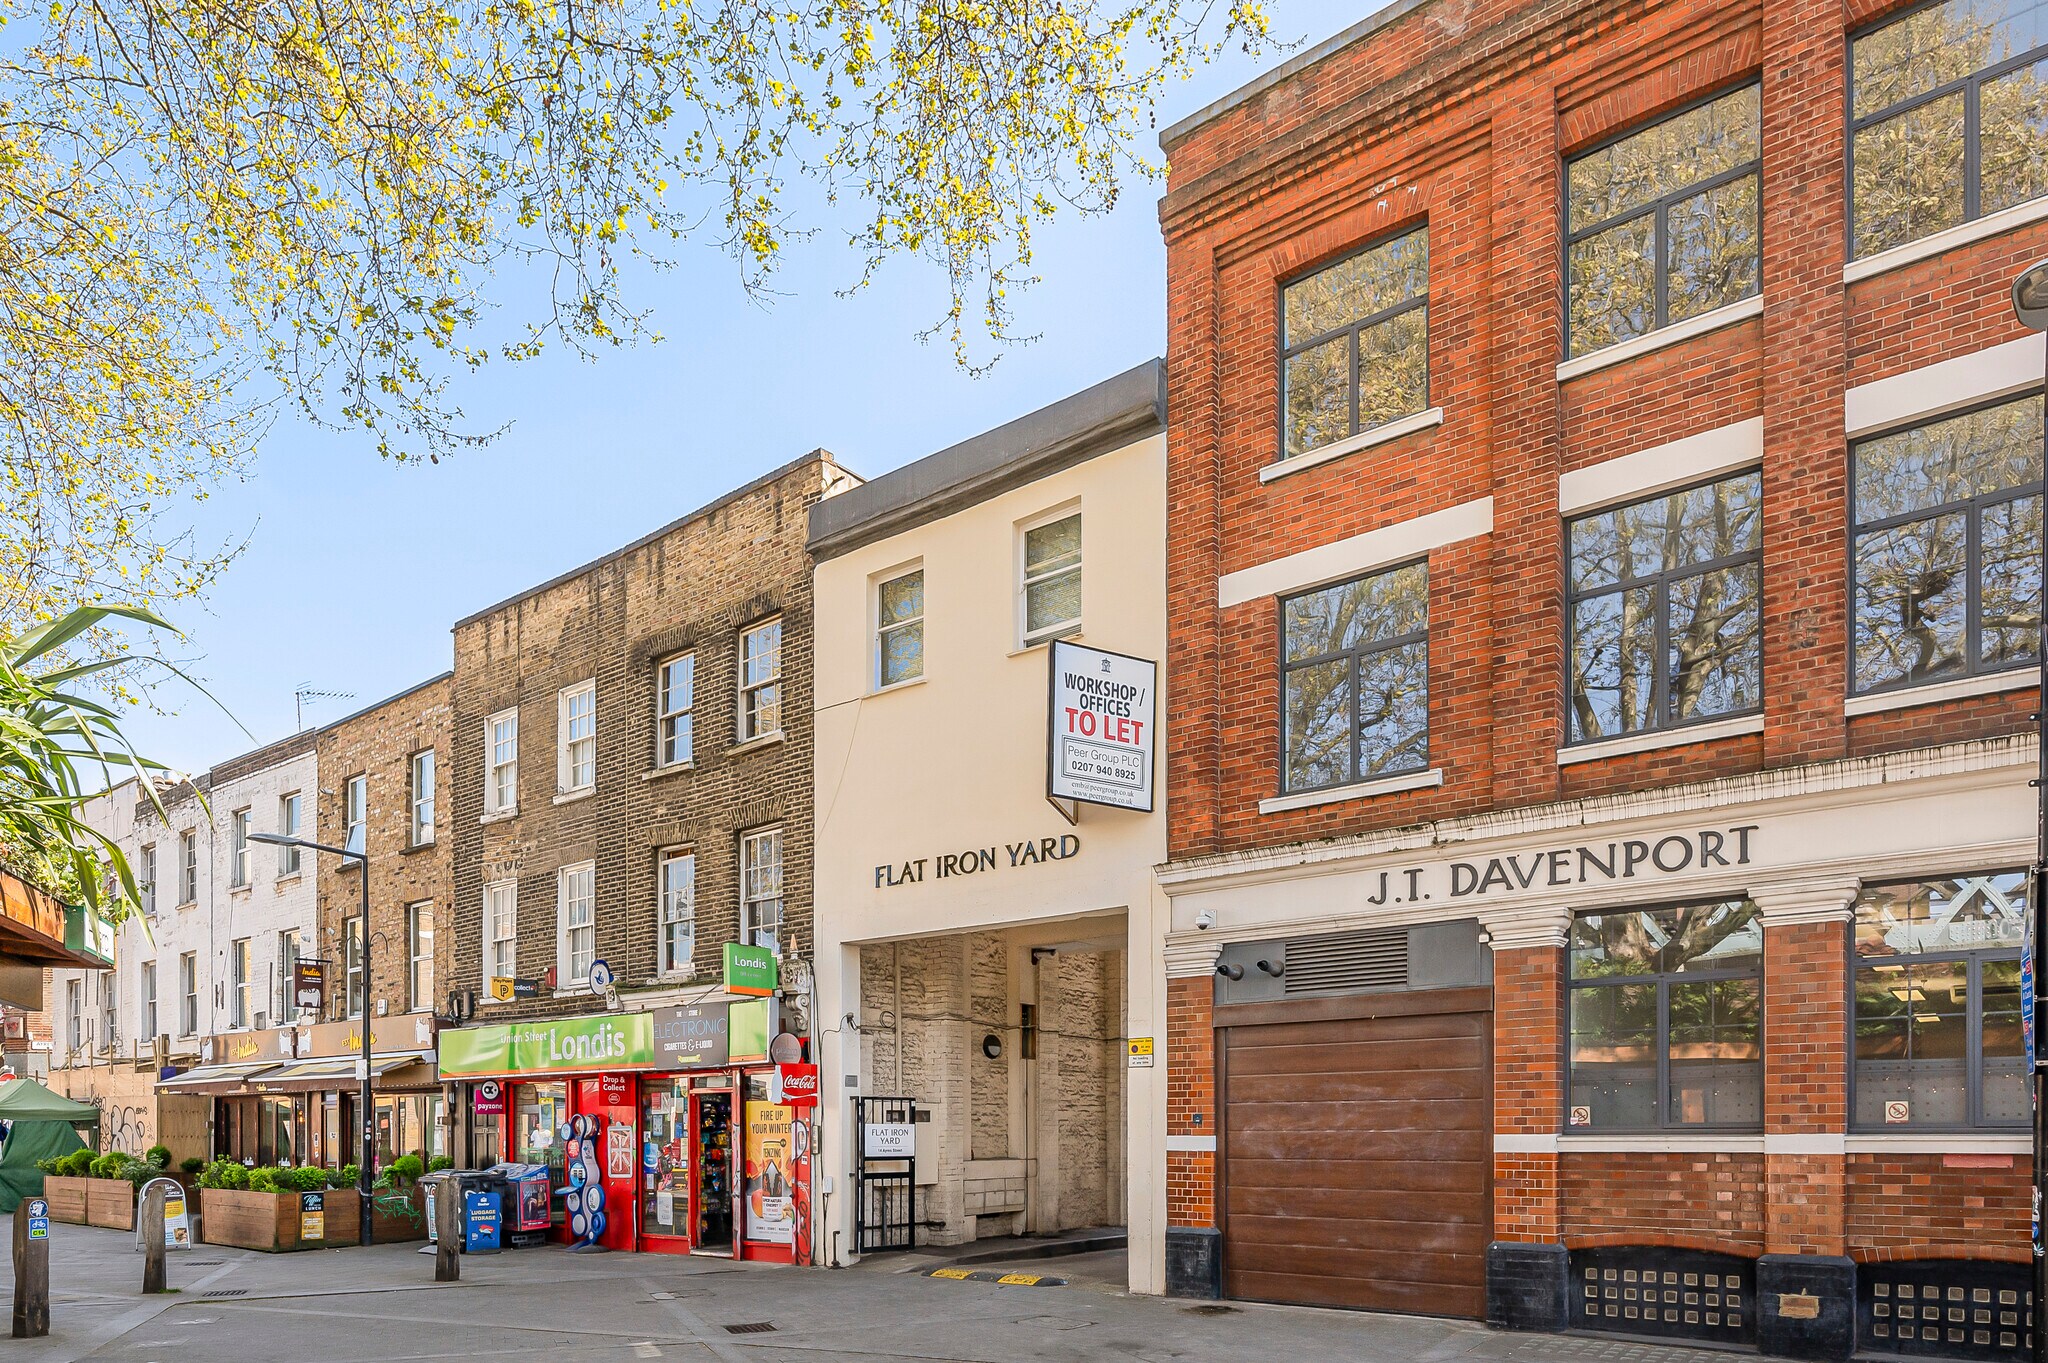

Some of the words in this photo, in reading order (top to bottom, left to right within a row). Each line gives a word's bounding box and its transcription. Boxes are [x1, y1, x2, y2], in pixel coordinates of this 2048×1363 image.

[1064, 672, 1136, 702] WORKSHOP
[1080, 694, 1130, 718] OFFICES
[1065, 707, 1096, 736] TO
[1104, 716, 1144, 745] LET
[1068, 745, 1088, 759] Peer
[1091, 750, 1119, 764] Group
[1122, 756, 1140, 768] PLC
[1072, 761, 1093, 772] 0207
[1097, 765, 1112, 776] 940
[1115, 768, 1136, 780] 8925
[1072, 789, 1133, 805] www.peergroup.co.uk
[875, 859, 928, 888] FLAT
[936, 847, 996, 879] IRON
[1005, 834, 1080, 867] YARD
[1367, 868, 1430, 905] J.T.
[1450, 825, 1760, 897] DAVENPORT
[734, 955, 767, 969] Londis
[654, 1018, 727, 1039] ELECTRONIC
[501, 1033, 523, 1044] Union
[525, 1031, 547, 1042] Street
[550, 1023, 626, 1061] Londis
[664, 1041, 687, 1051] CIGARETTES
[687, 1039, 695, 1052] &
[696, 1040, 713, 1049] E-LIQUID
[603, 1076, 619, 1084] Drop
[760, 1110, 773, 1121] FIRE
[775, 1110, 784, 1120] UP
[752, 1124, 768, 1134] YOUR
[769, 1123, 792, 1134] WINTER
[763, 1148, 781, 1158] TENZING
